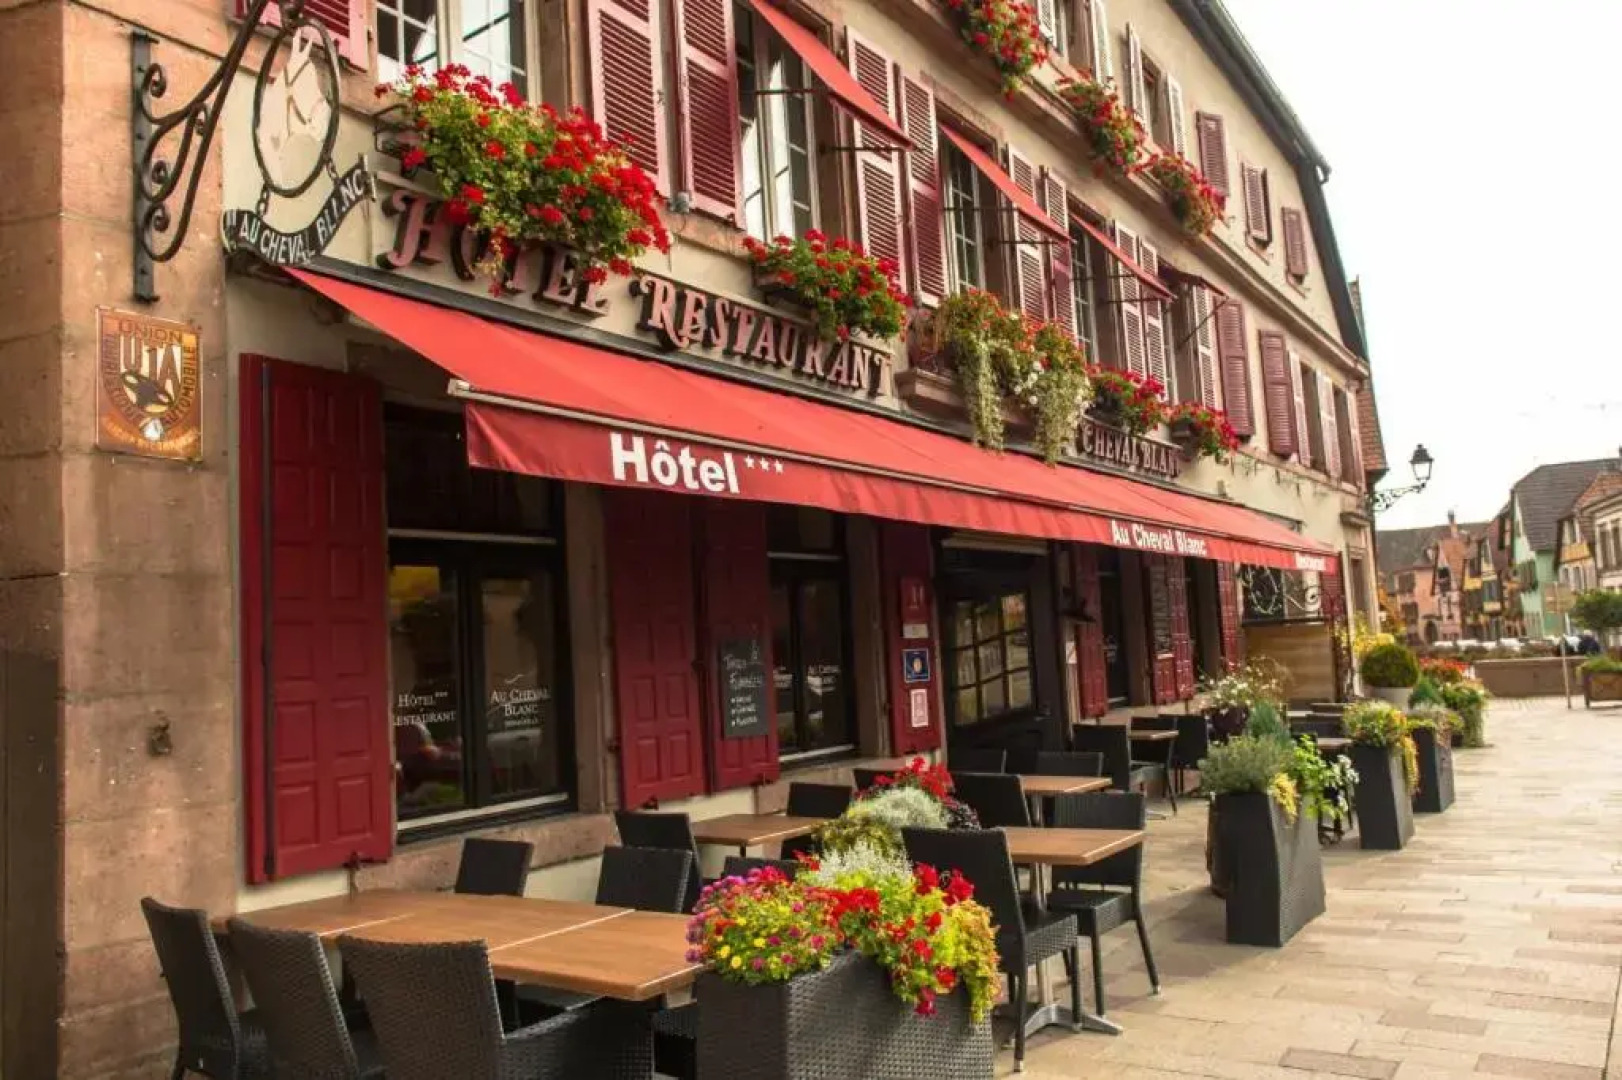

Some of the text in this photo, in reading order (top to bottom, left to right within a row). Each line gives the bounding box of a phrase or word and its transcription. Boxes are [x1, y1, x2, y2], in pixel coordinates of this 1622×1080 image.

[239, 213, 261, 244] AU
[260, 229, 316, 265] CHEVAL
[118, 318, 183, 343] UNION
[634, 274, 896, 403] RESTAURANT
[610, 431, 740, 493] Hôtel
[1111, 519, 1207, 557] Au Cheval Blanc
